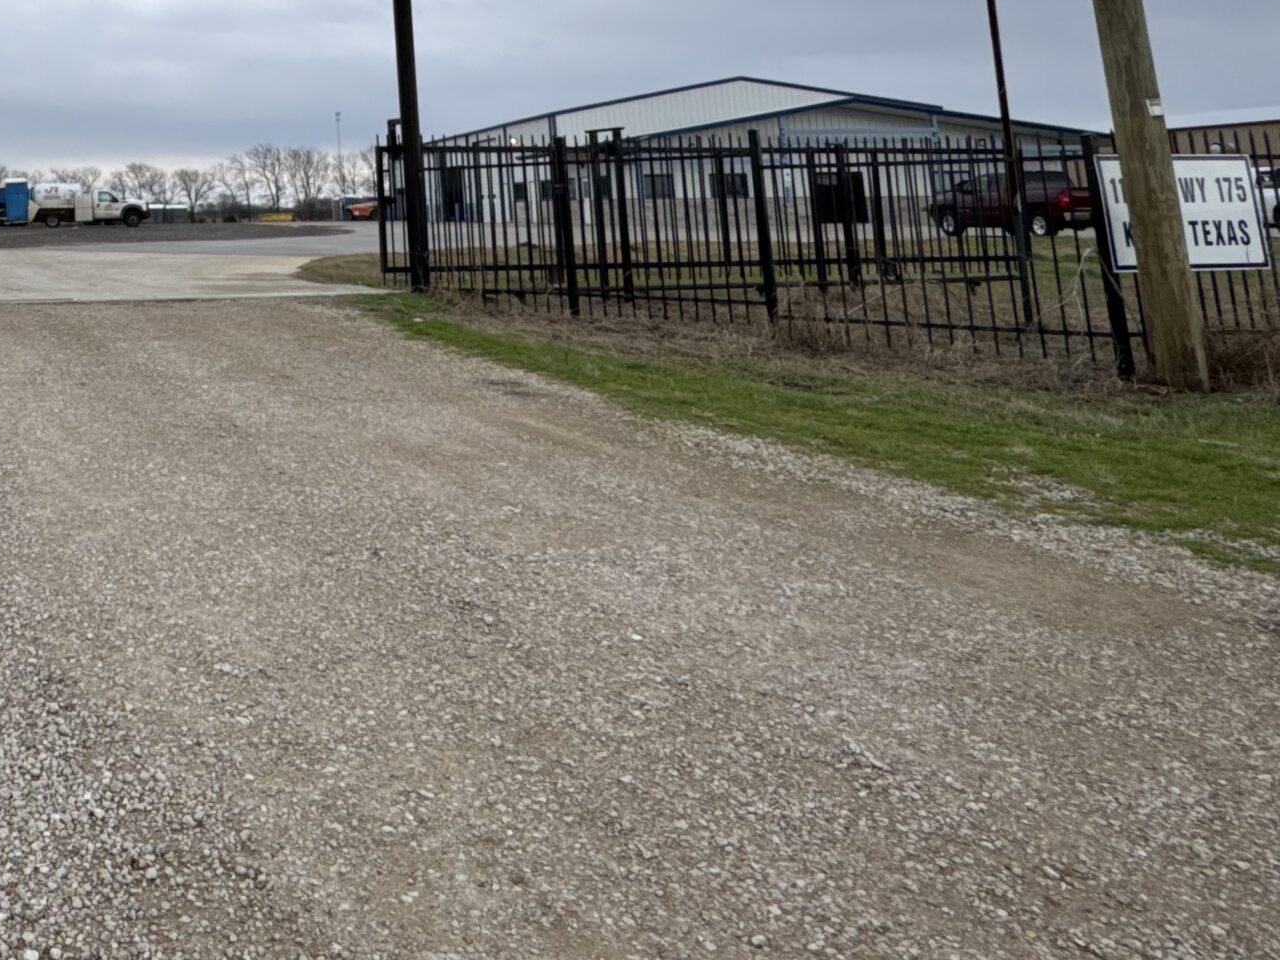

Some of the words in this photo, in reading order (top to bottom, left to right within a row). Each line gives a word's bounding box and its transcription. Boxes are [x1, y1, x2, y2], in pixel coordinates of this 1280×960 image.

[1177, 177, 1207, 203] WY
[1215, 177, 1247, 203] 175
[1188, 219, 1251, 246] TEXAS
